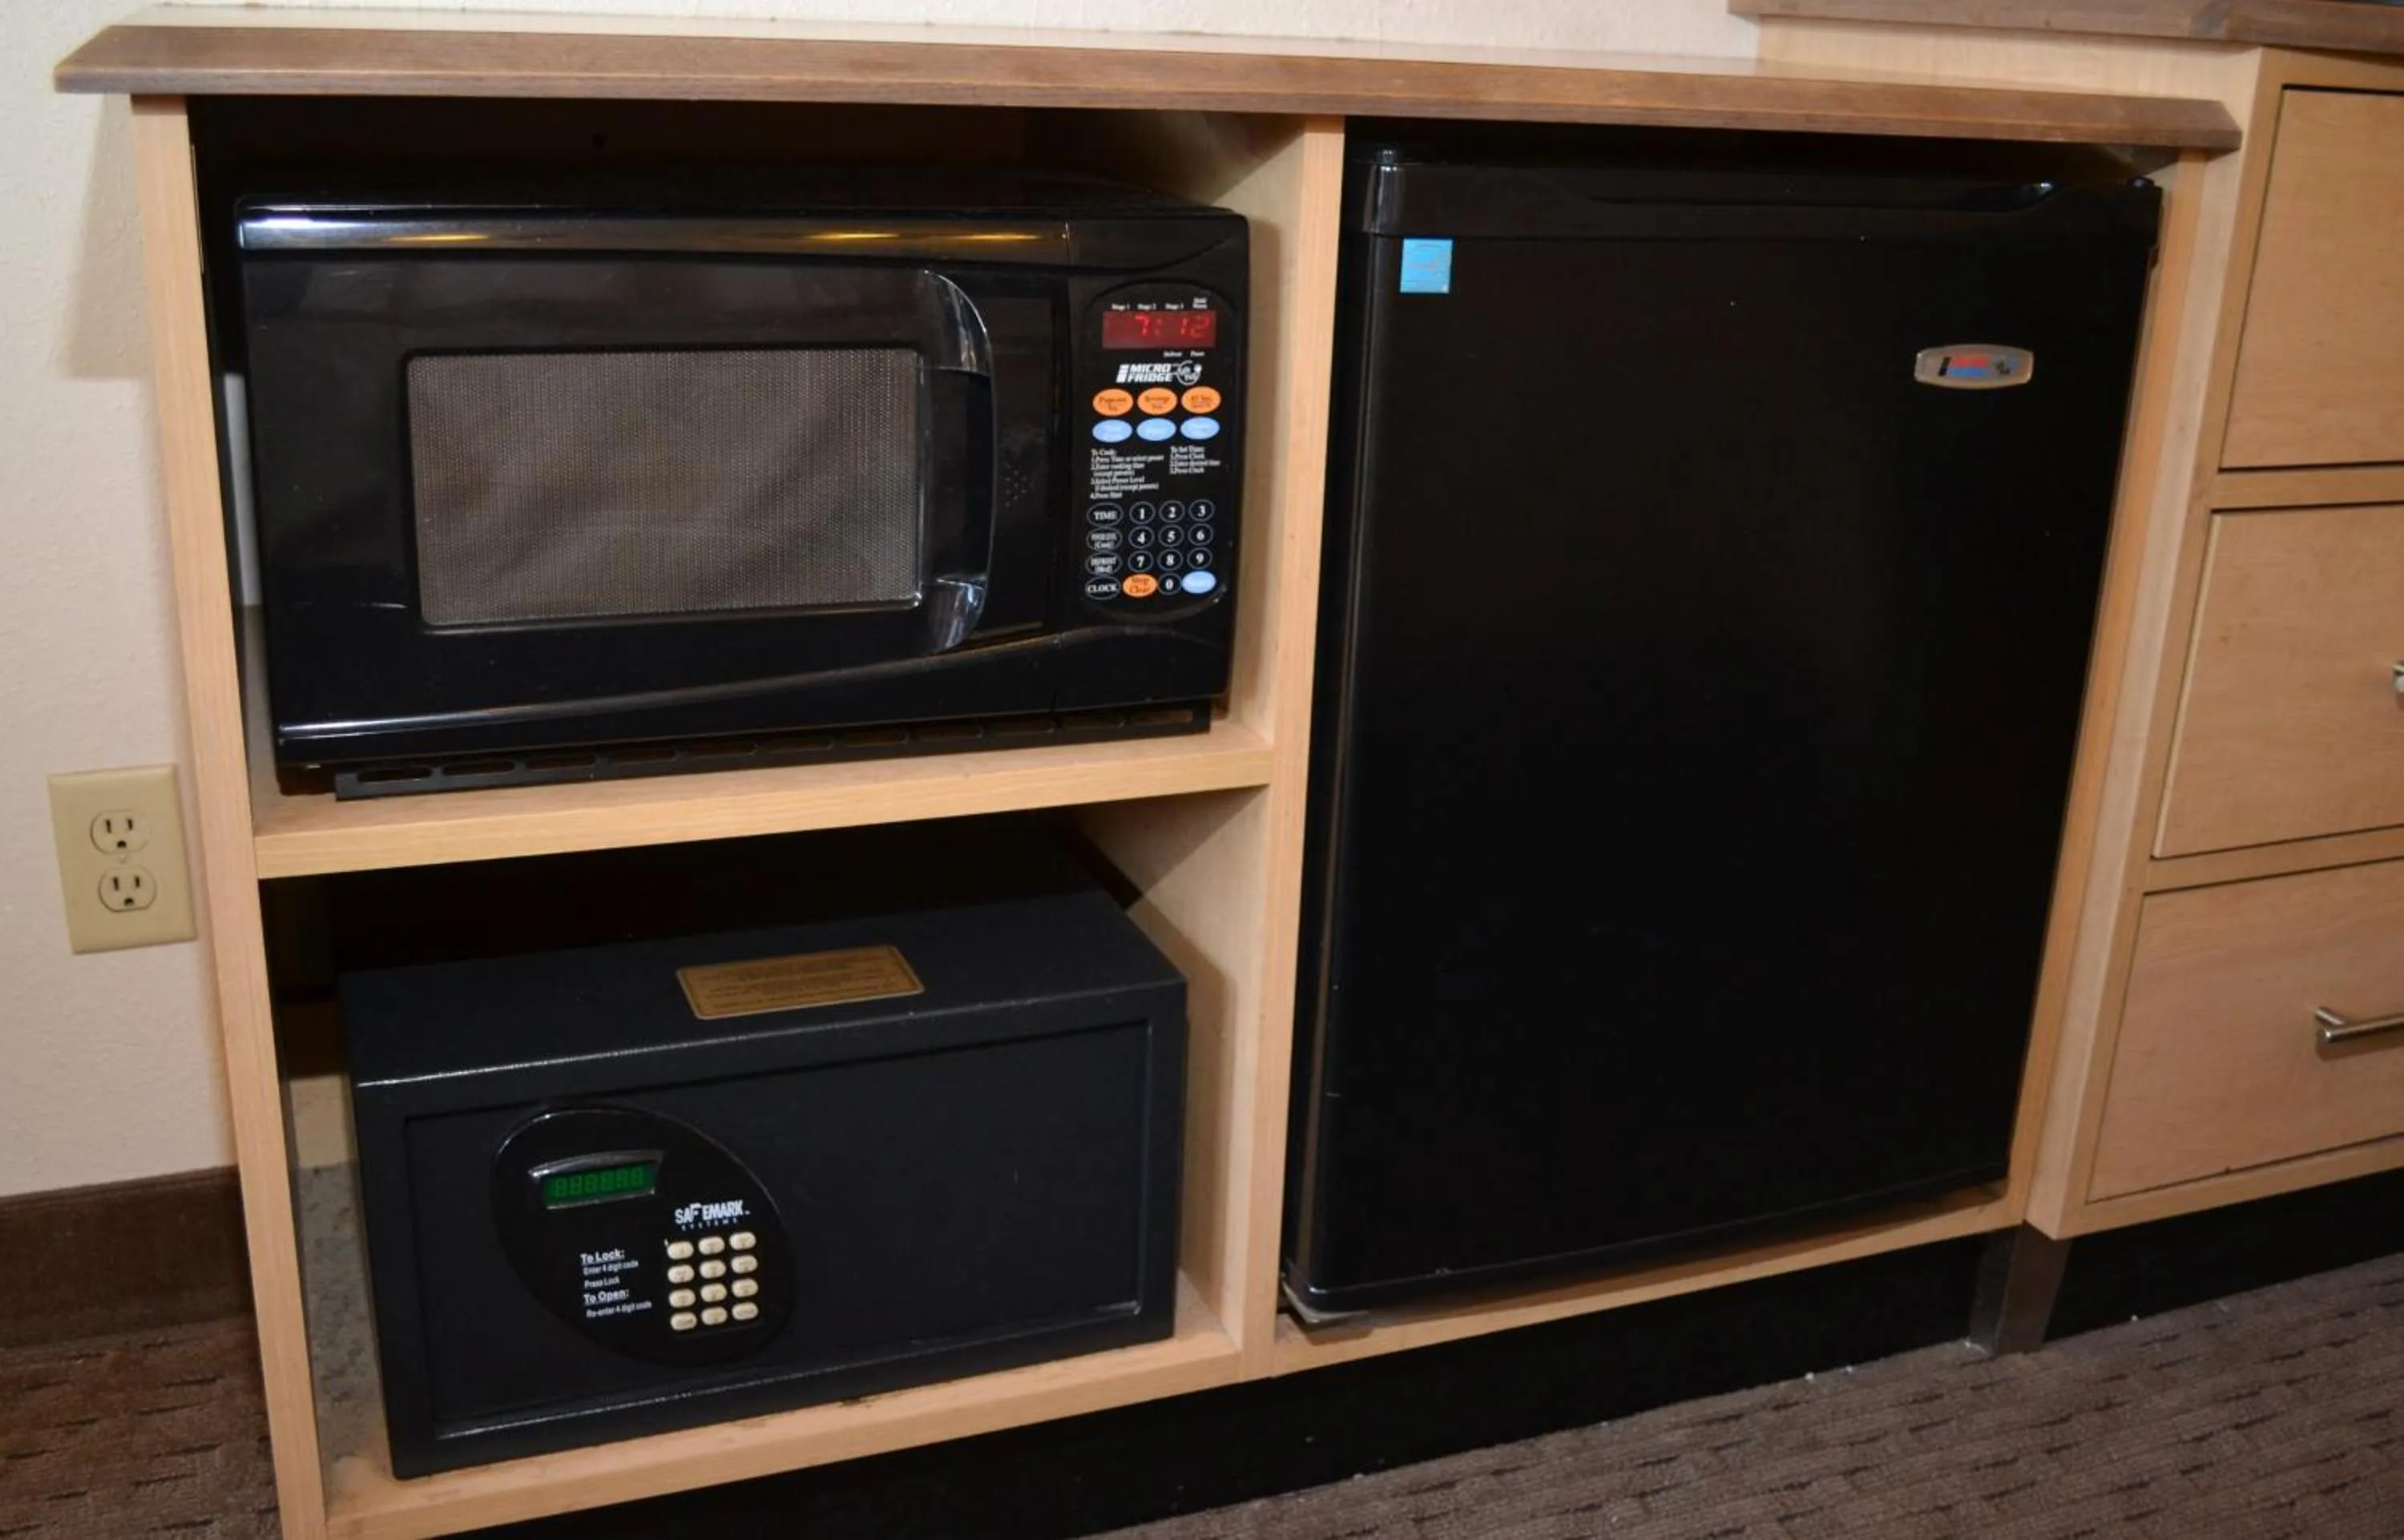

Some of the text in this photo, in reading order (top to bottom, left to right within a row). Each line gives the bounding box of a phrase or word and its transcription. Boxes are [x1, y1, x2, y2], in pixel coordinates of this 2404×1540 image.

[1129, 364, 1172, 373] MICRO
[1127, 373, 1173, 383] FRIDGE
[1092, 510, 1118, 521] TIME
[1139, 507, 1146, 520] 1
[1168, 506, 1176, 519] 2
[1197, 504, 1206, 518] 3
[1137, 531, 1146, 544] 4
[1167, 530, 1176, 542] 5
[1196, 529, 1205, 541] 6
[1136, 555, 1145, 568] 7
[1166, 553, 1175, 566] 8
[1196, 552, 1204, 565] 9
[1087, 583, 1117, 592] CLOCK
[1165, 578, 1174, 591] 0
[674, 1199, 744, 1225] SAFEMARK
[580, 1248, 625, 1266] To Lock:
[583, 1288, 629, 1306] To Open:
